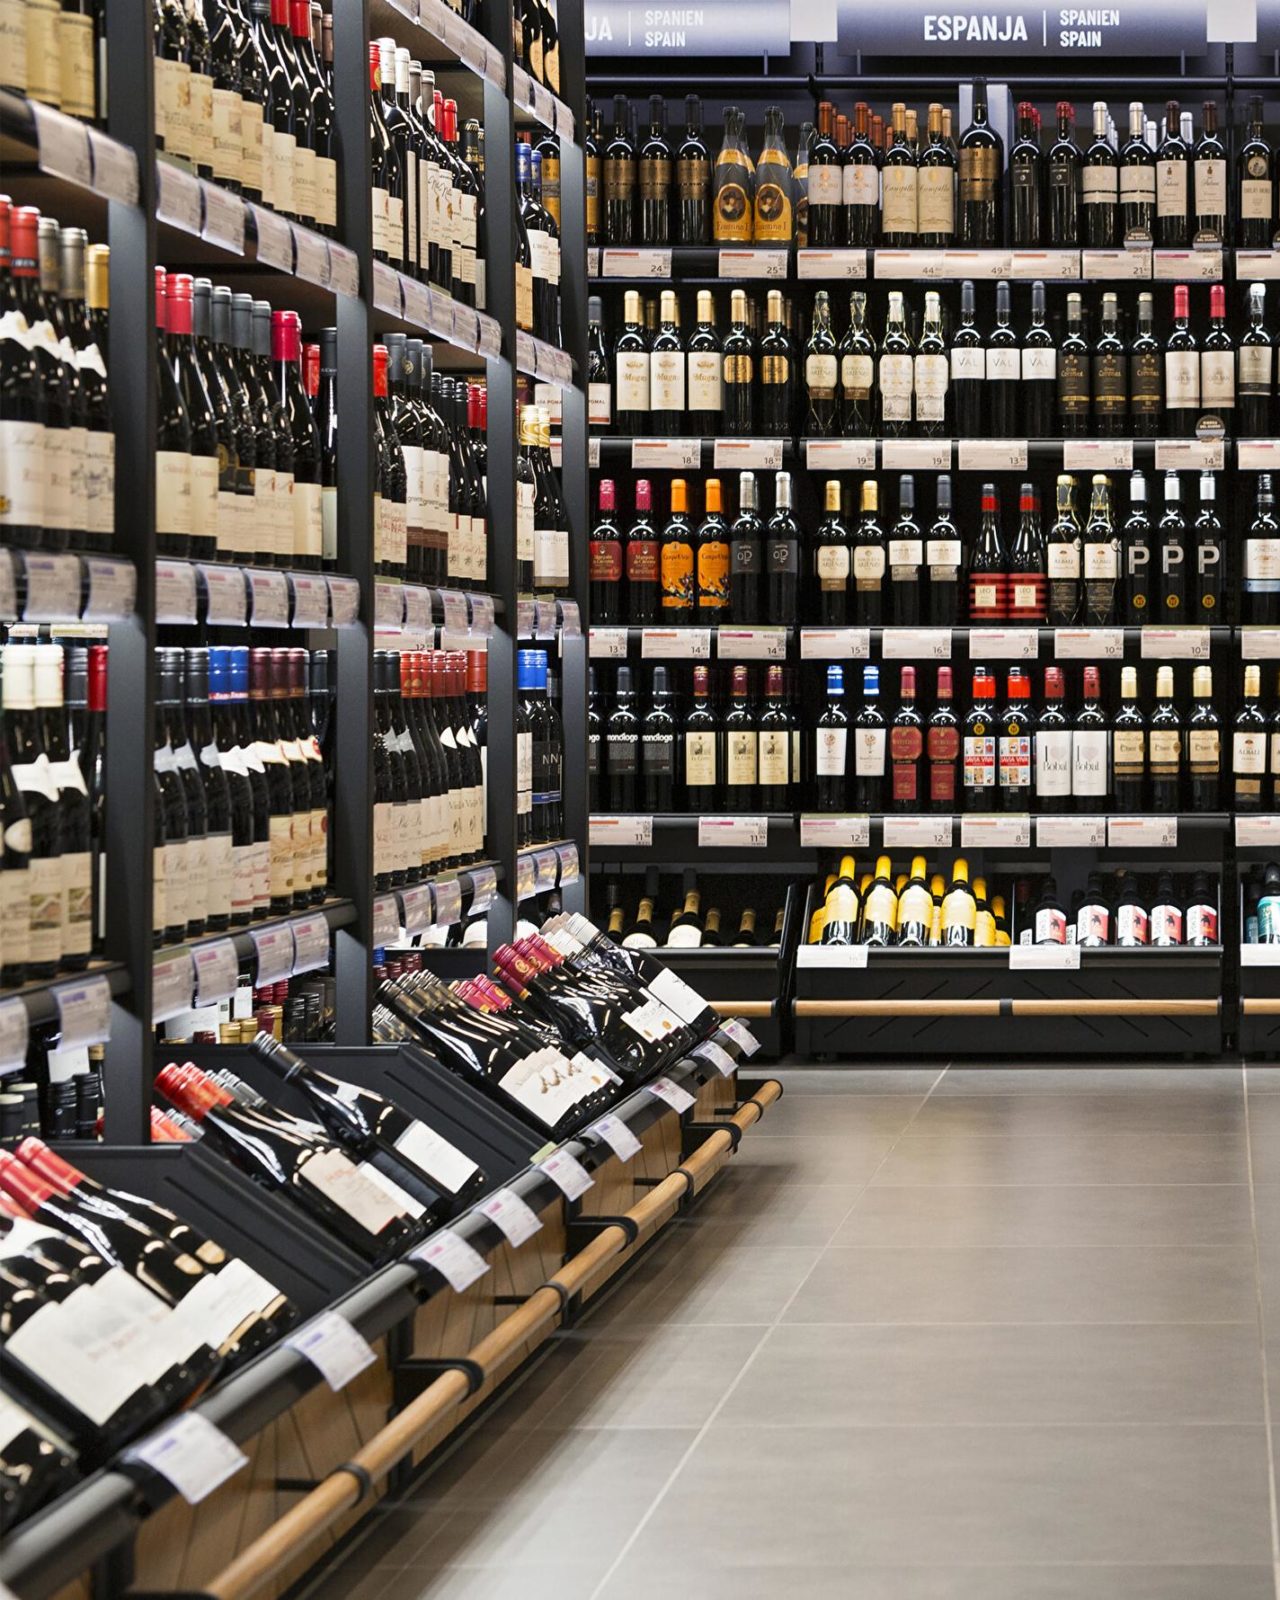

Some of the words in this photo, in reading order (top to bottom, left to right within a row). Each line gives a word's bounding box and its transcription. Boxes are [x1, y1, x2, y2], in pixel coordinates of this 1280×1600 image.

[645, 10, 704, 26] SPANIEN
[1060, 9, 1120, 26] SPANIEN
[924, 15, 1029, 41] ESPANJA
[645, 31, 686, 47] SPAIN
[1060, 31, 1102, 47] SPAIN
[847, 266, 858, 274] 35
[1129, 546, 1150, 574] P
[1162, 546, 1184, 574] P
[1198, 546, 1220, 574] P
